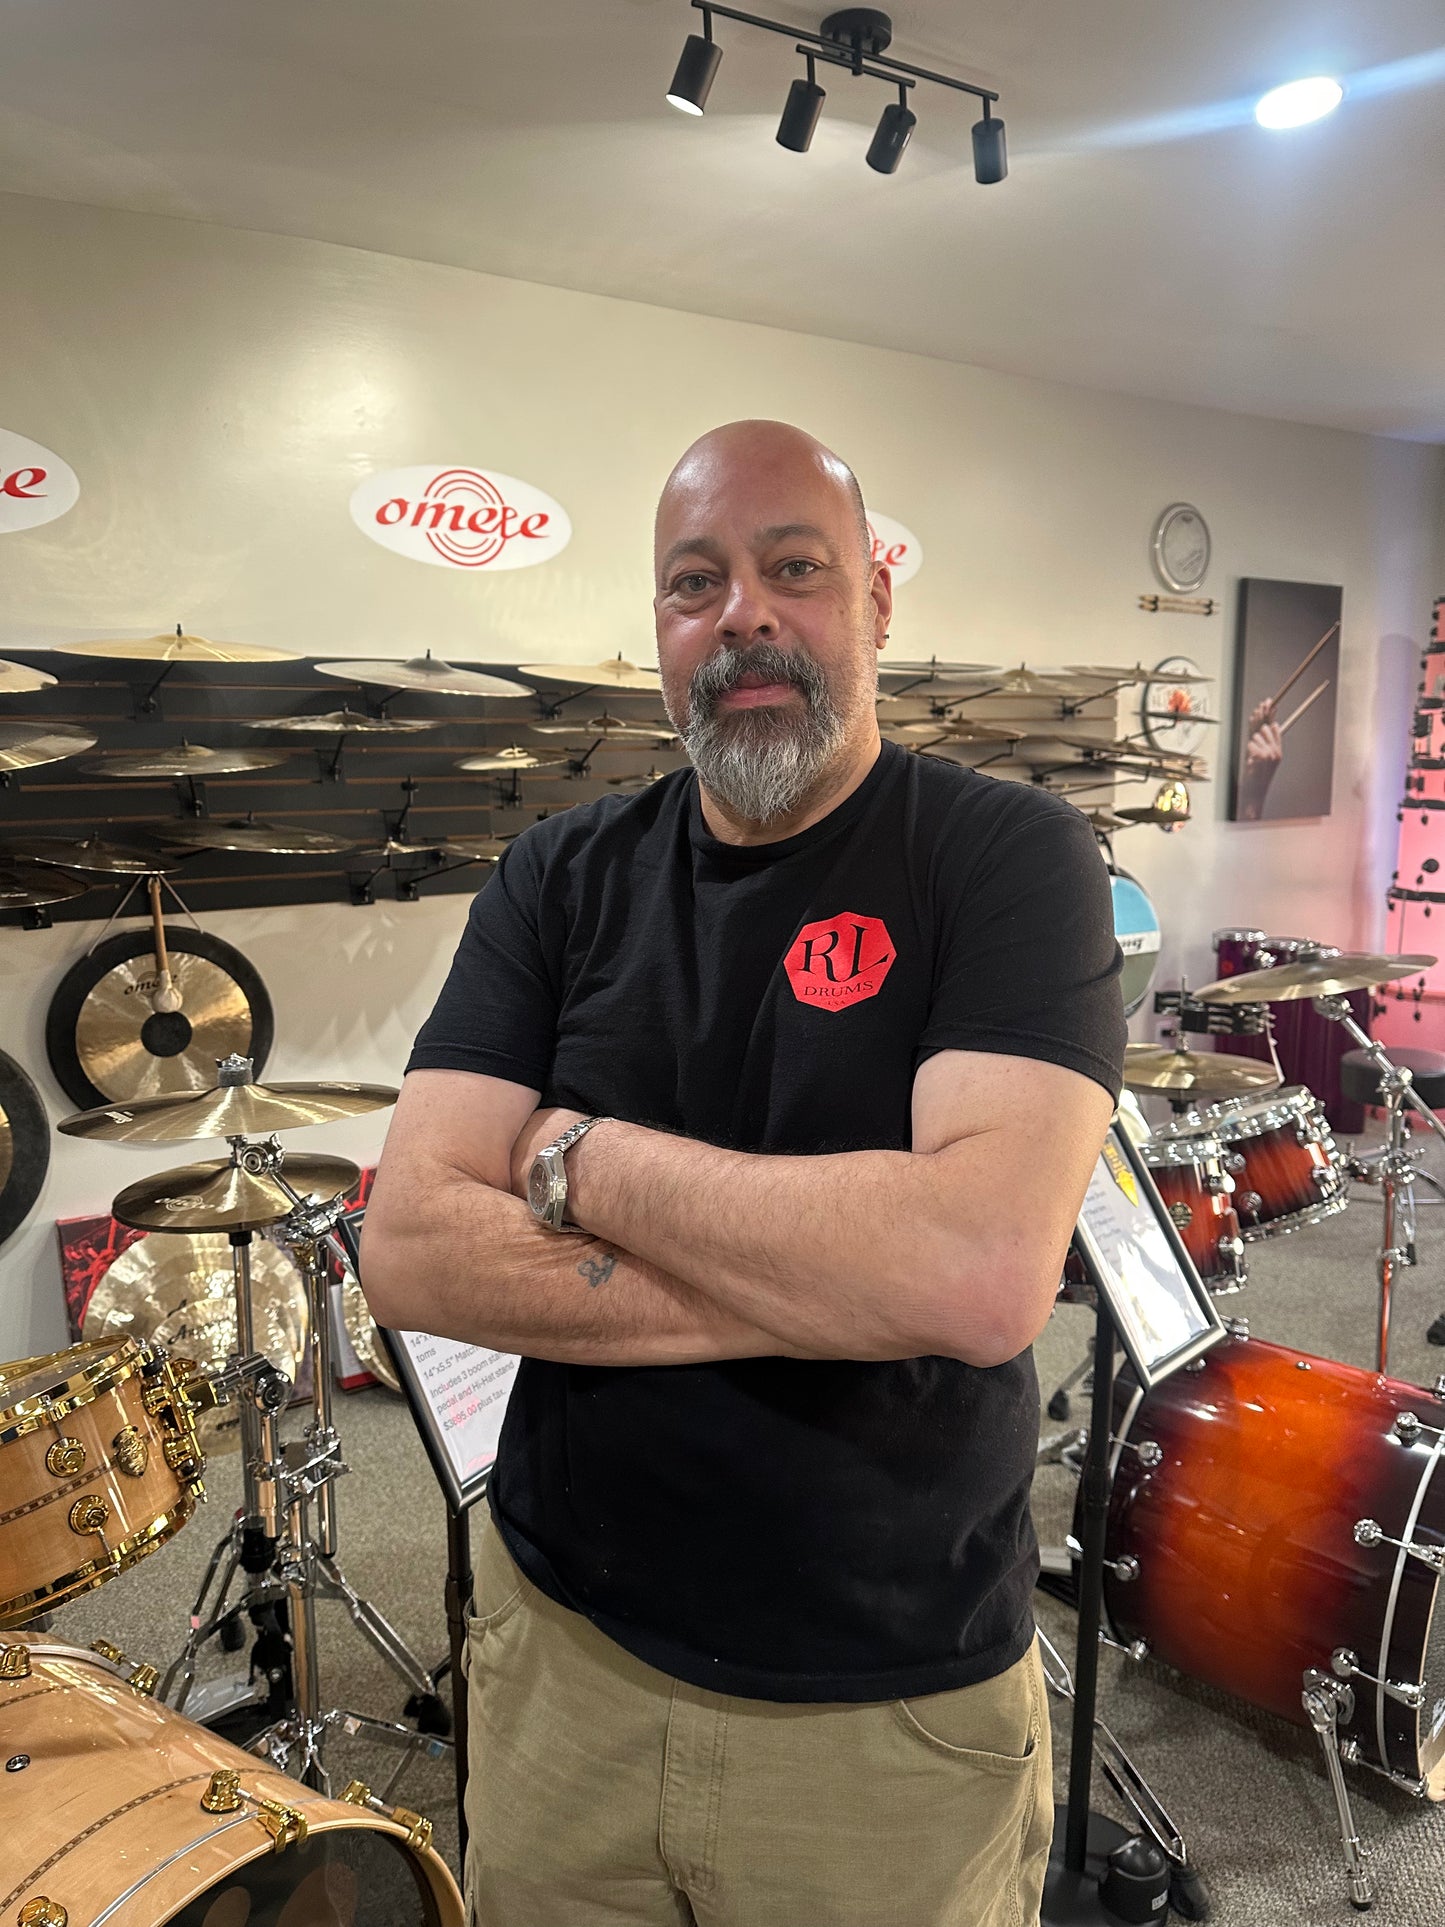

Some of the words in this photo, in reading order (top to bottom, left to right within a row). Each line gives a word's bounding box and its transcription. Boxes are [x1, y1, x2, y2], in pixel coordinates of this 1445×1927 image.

[796, 924, 889, 982] RL
[804, 981, 874, 997] DRUMS
[416, 1347, 437, 1363] toms
[430, 1376, 462, 1398] Includes
[462, 1370, 468, 1380] 3
[468, 1360, 489, 1376] boom
[436, 1395, 458, 1415] pedal
[458, 1387, 473, 1401] and
[472, 1373, 496, 1391] Hi-Hat
[495, 1360, 515, 1378] stand
[477, 1395, 493, 1411] plus
